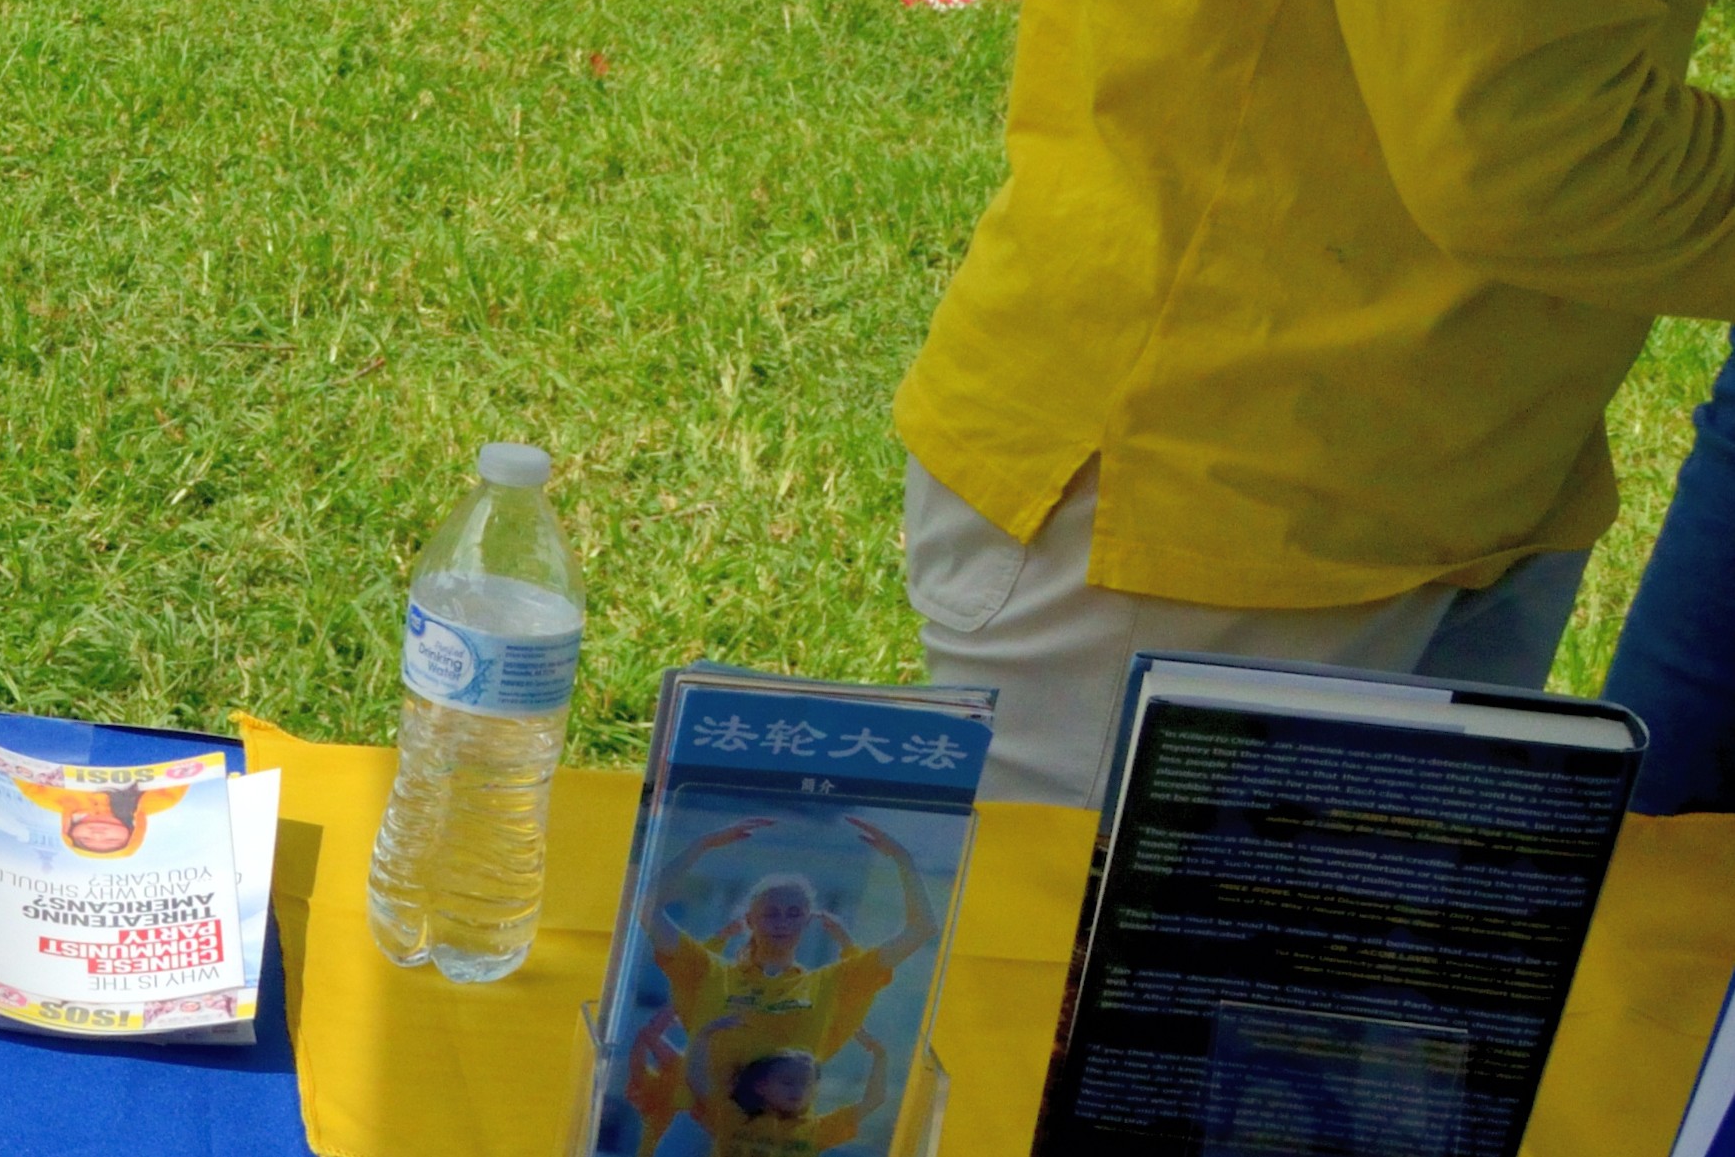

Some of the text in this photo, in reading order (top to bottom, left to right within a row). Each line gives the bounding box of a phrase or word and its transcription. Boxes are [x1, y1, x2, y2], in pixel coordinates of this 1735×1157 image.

[418, 642, 463, 671] Drinking
[427, 661, 462, 682] Water
[691, 713, 969, 771] 法轮大法
[75, 768, 154, 781] SOS!
[88, 865, 212, 885] YOU CARE?
[84, 886, 136, 899] WHY
[143, 881, 189, 896] AND
[32, 891, 215, 910] AMERICANS?
[21, 905, 216, 928] THREATENING
[127, 919, 215, 941] PARTY
[45, 935, 216, 959] COMMUNIST
[96, 949, 218, 972] CHINESE
[87, 966, 219, 990] WHY IS THE
